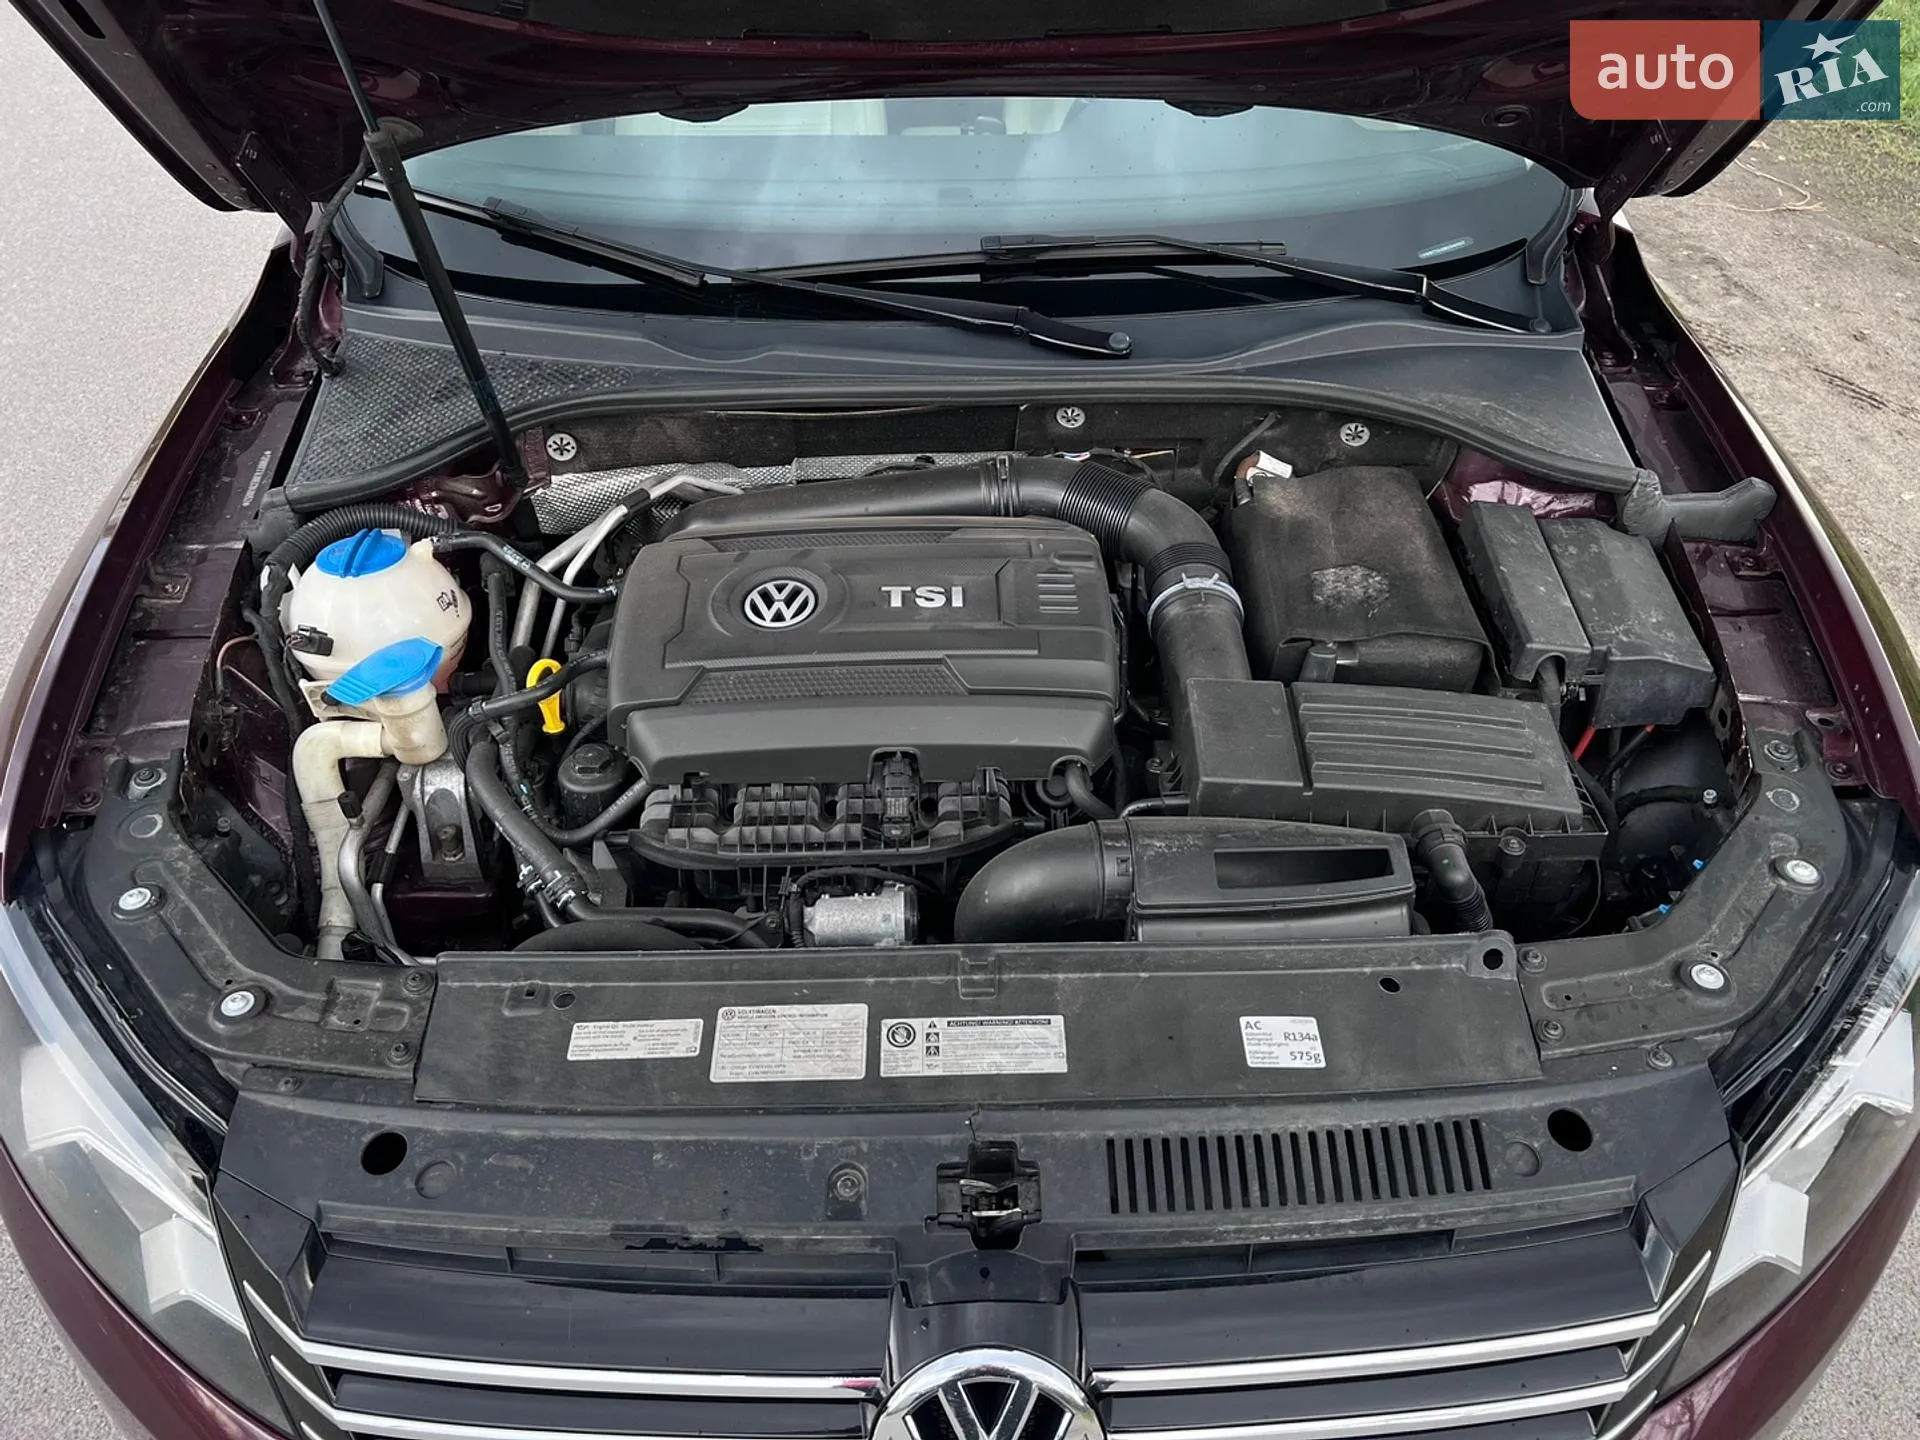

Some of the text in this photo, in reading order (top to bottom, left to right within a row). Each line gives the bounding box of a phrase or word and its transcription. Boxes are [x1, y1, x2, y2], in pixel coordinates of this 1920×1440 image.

[880, 585, 964, 608] TSI
[1244, 1021, 1262, 1030] AC
[1283, 1032, 1319, 1042] R134a
